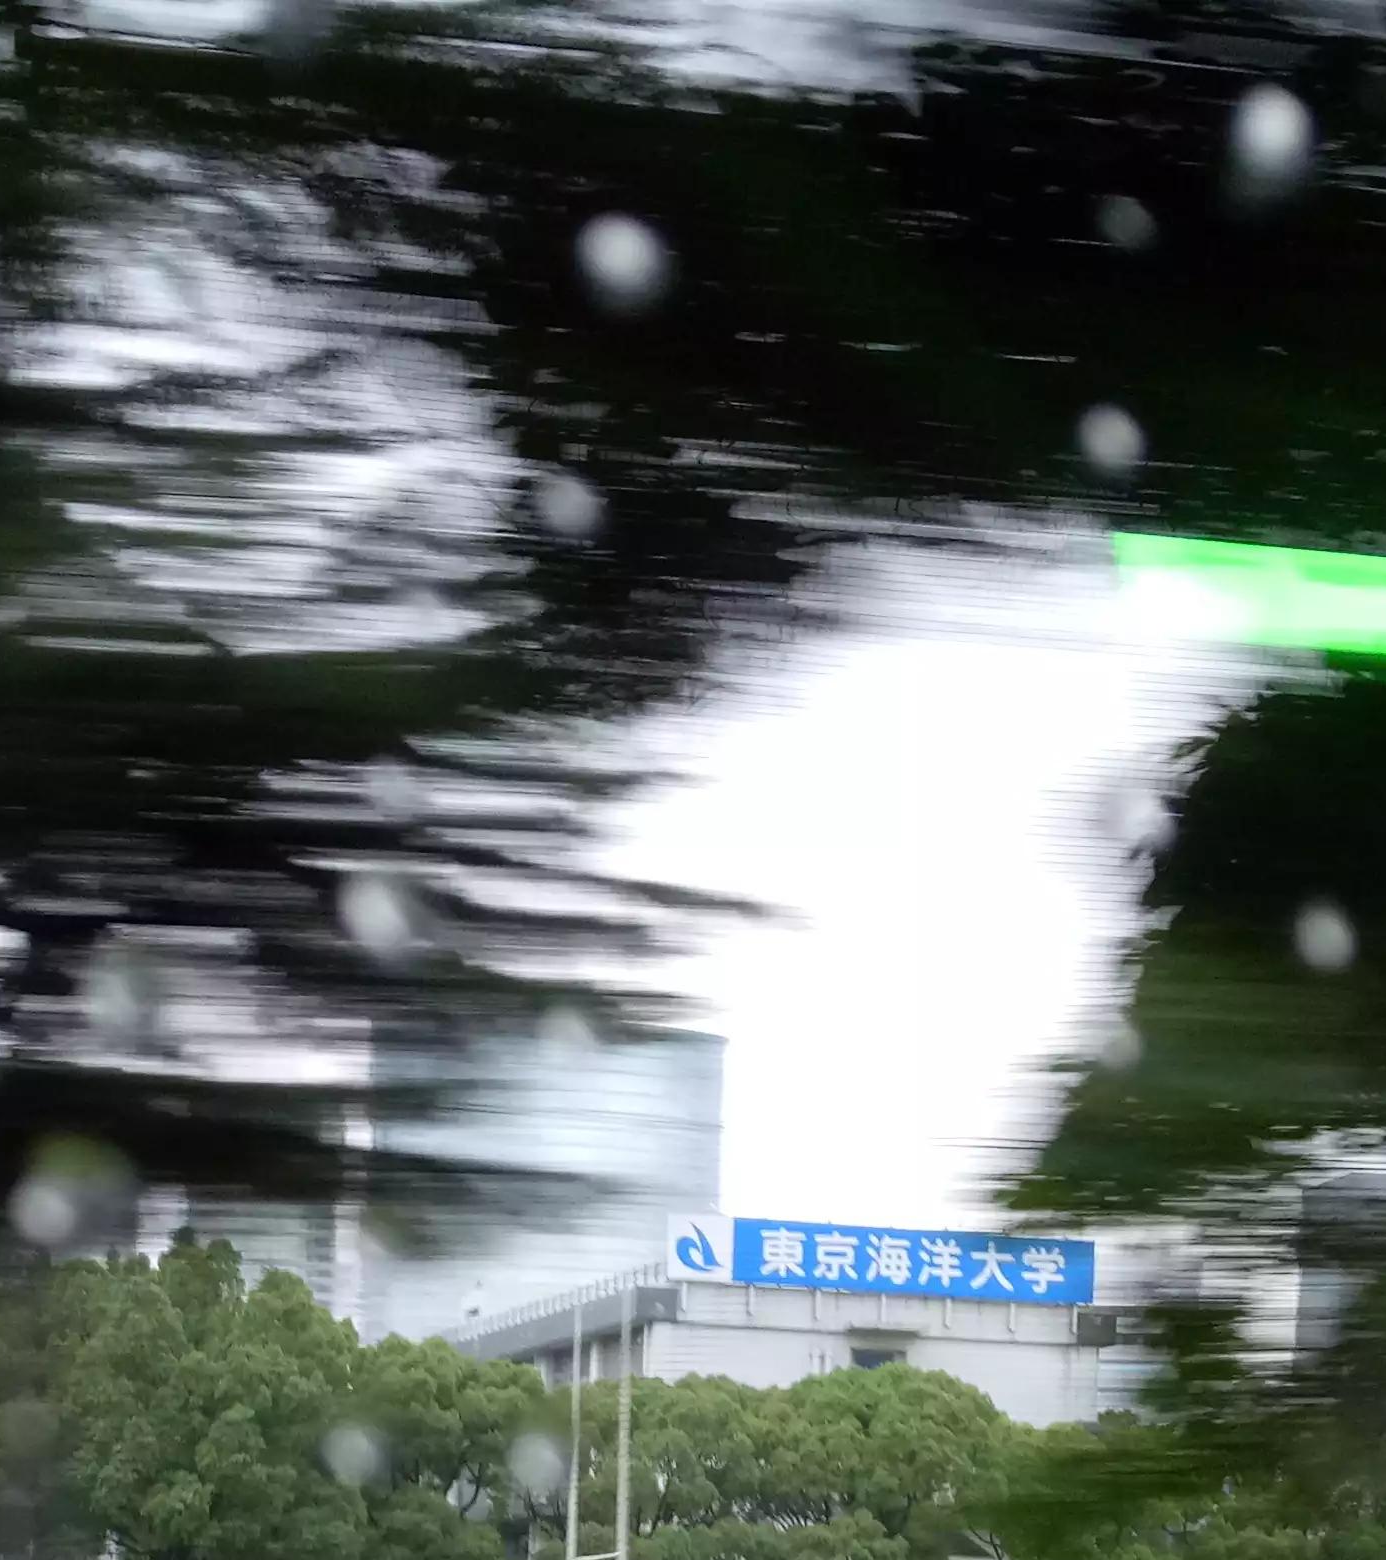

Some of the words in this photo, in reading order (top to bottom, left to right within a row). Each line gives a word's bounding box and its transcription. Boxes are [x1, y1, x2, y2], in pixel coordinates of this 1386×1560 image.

[759, 1227, 1066, 1294] 東京海洋大学
